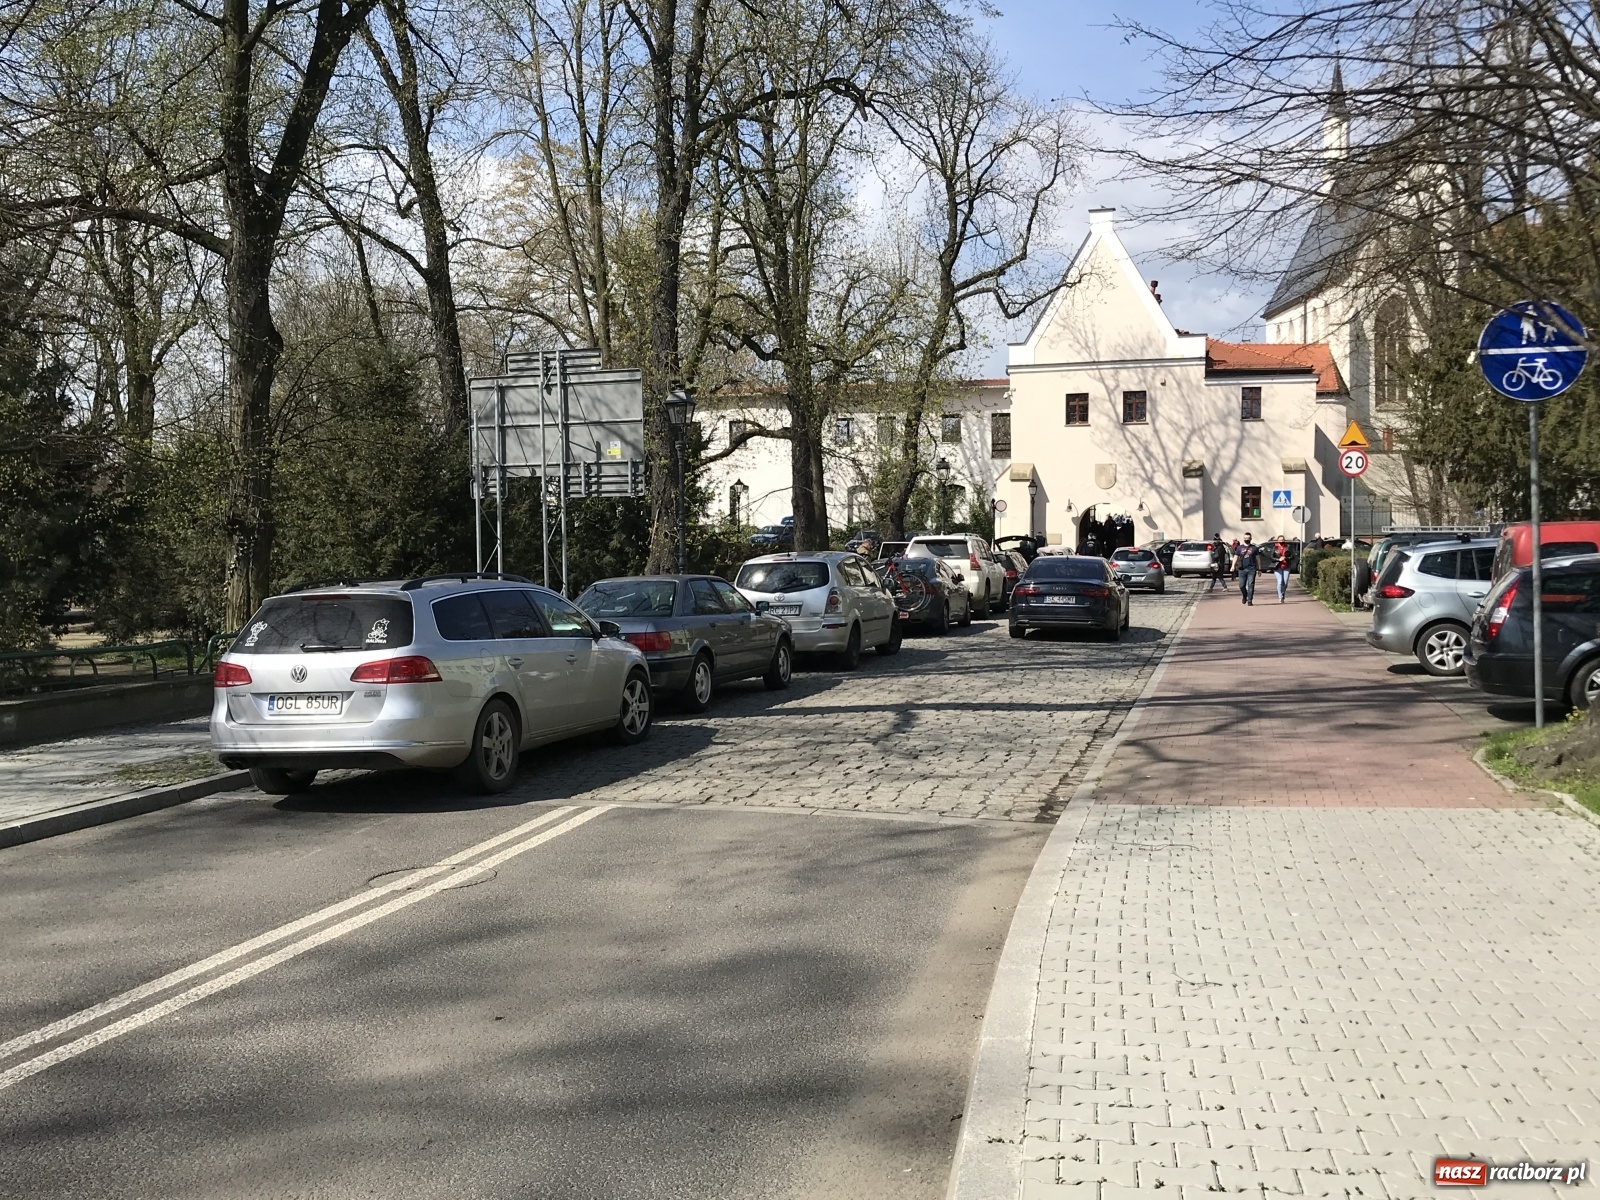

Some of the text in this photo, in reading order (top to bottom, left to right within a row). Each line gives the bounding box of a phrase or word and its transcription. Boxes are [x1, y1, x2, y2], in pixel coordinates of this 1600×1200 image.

[1344, 455, 1365, 469] 20
[276, 696, 301, 710] OGL
[306, 695, 339, 710] 85UR
